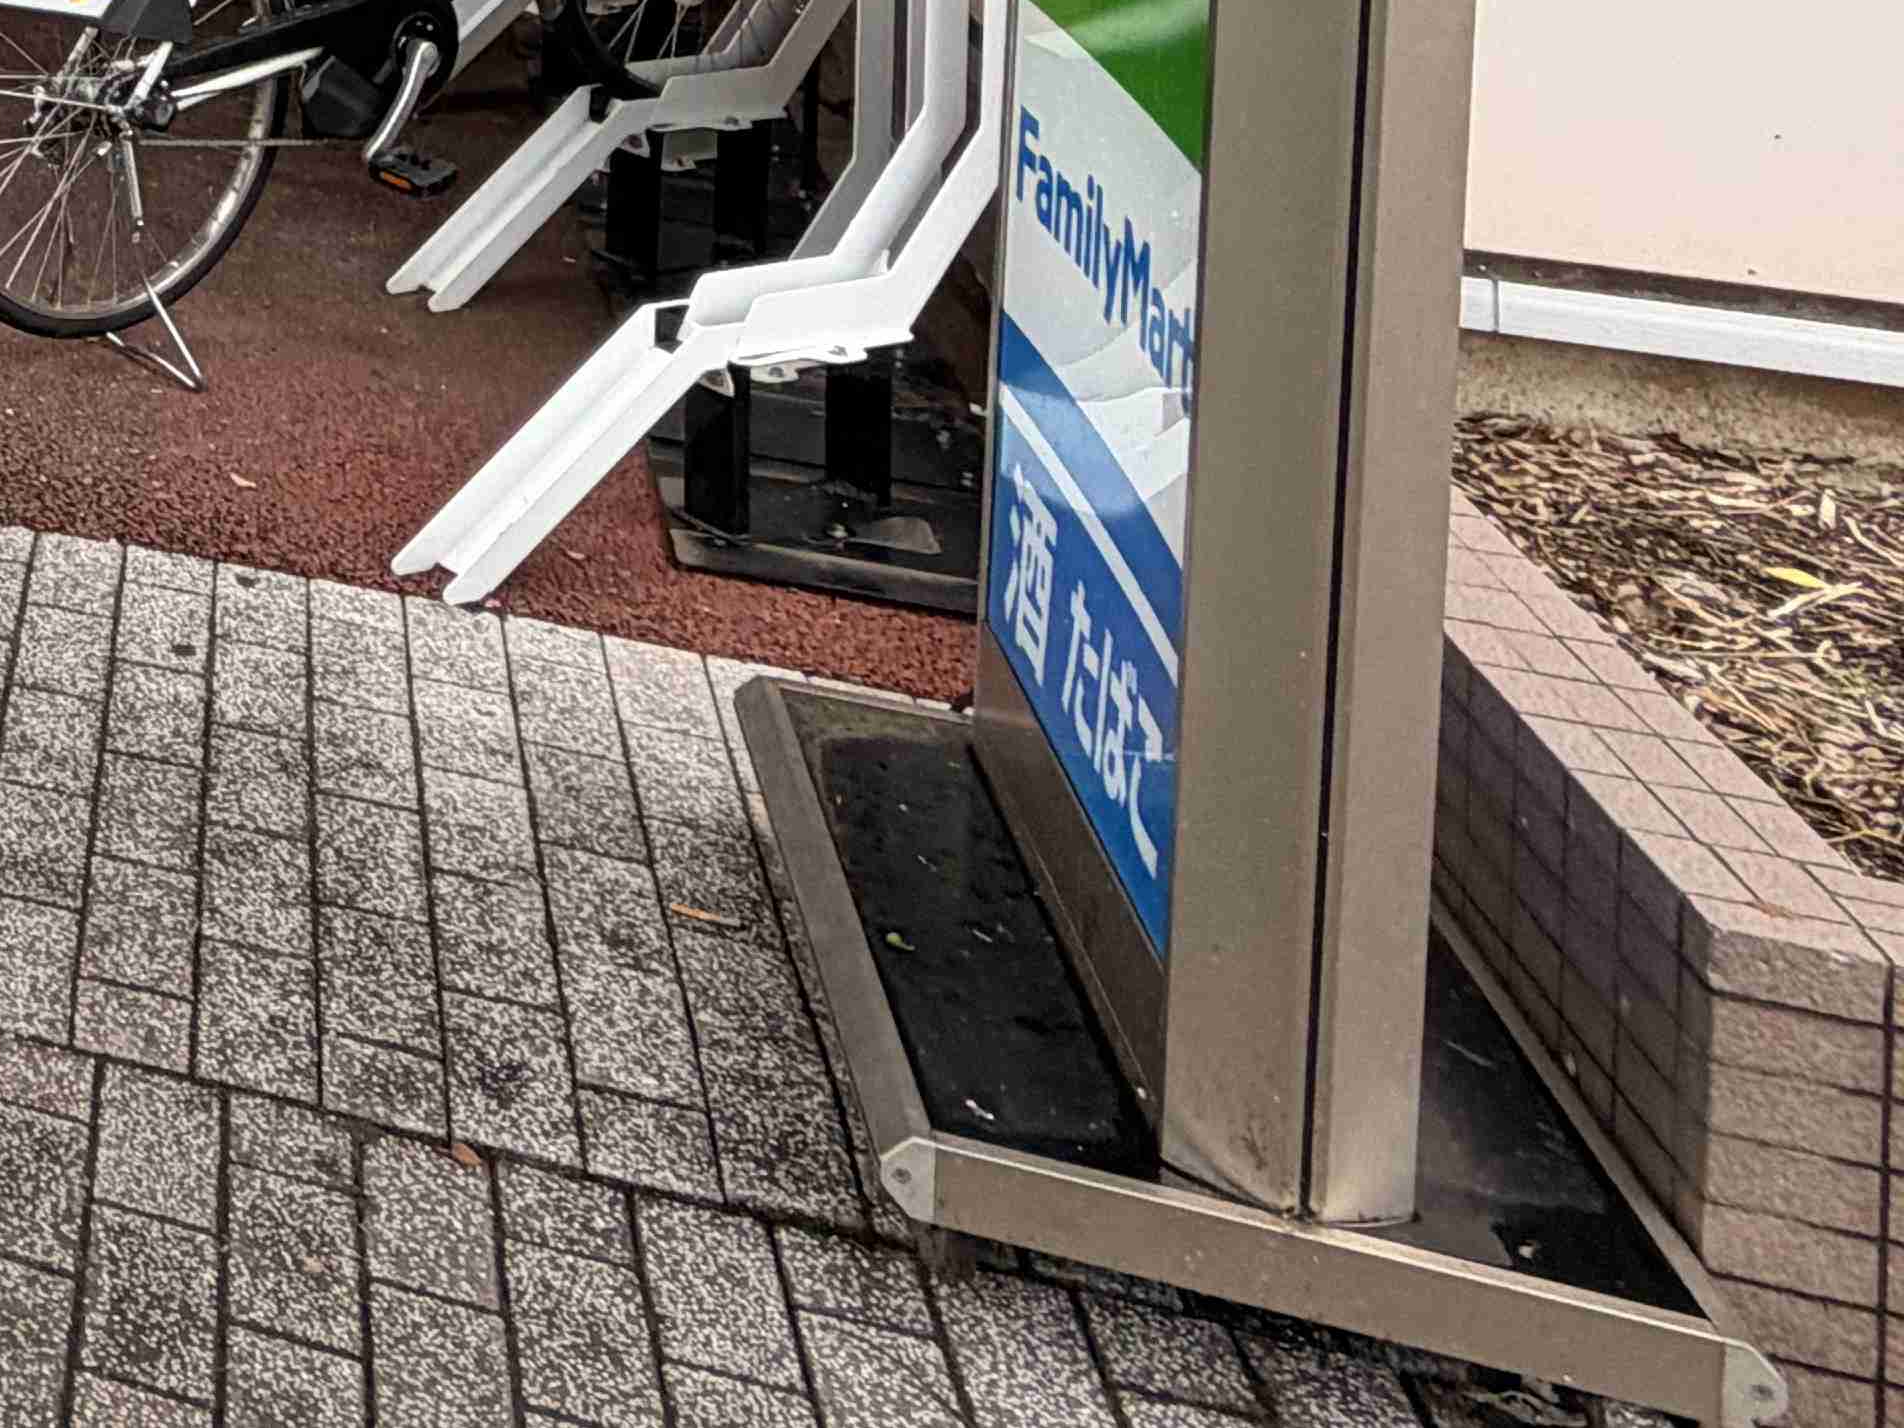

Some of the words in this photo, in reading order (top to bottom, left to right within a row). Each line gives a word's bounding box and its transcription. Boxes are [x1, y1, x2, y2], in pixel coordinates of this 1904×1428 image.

[1016, 104, 1194, 418] FamilyMart
[1004, 463, 1058, 686] 酒
[1063, 579, 1164, 880] たばこ
